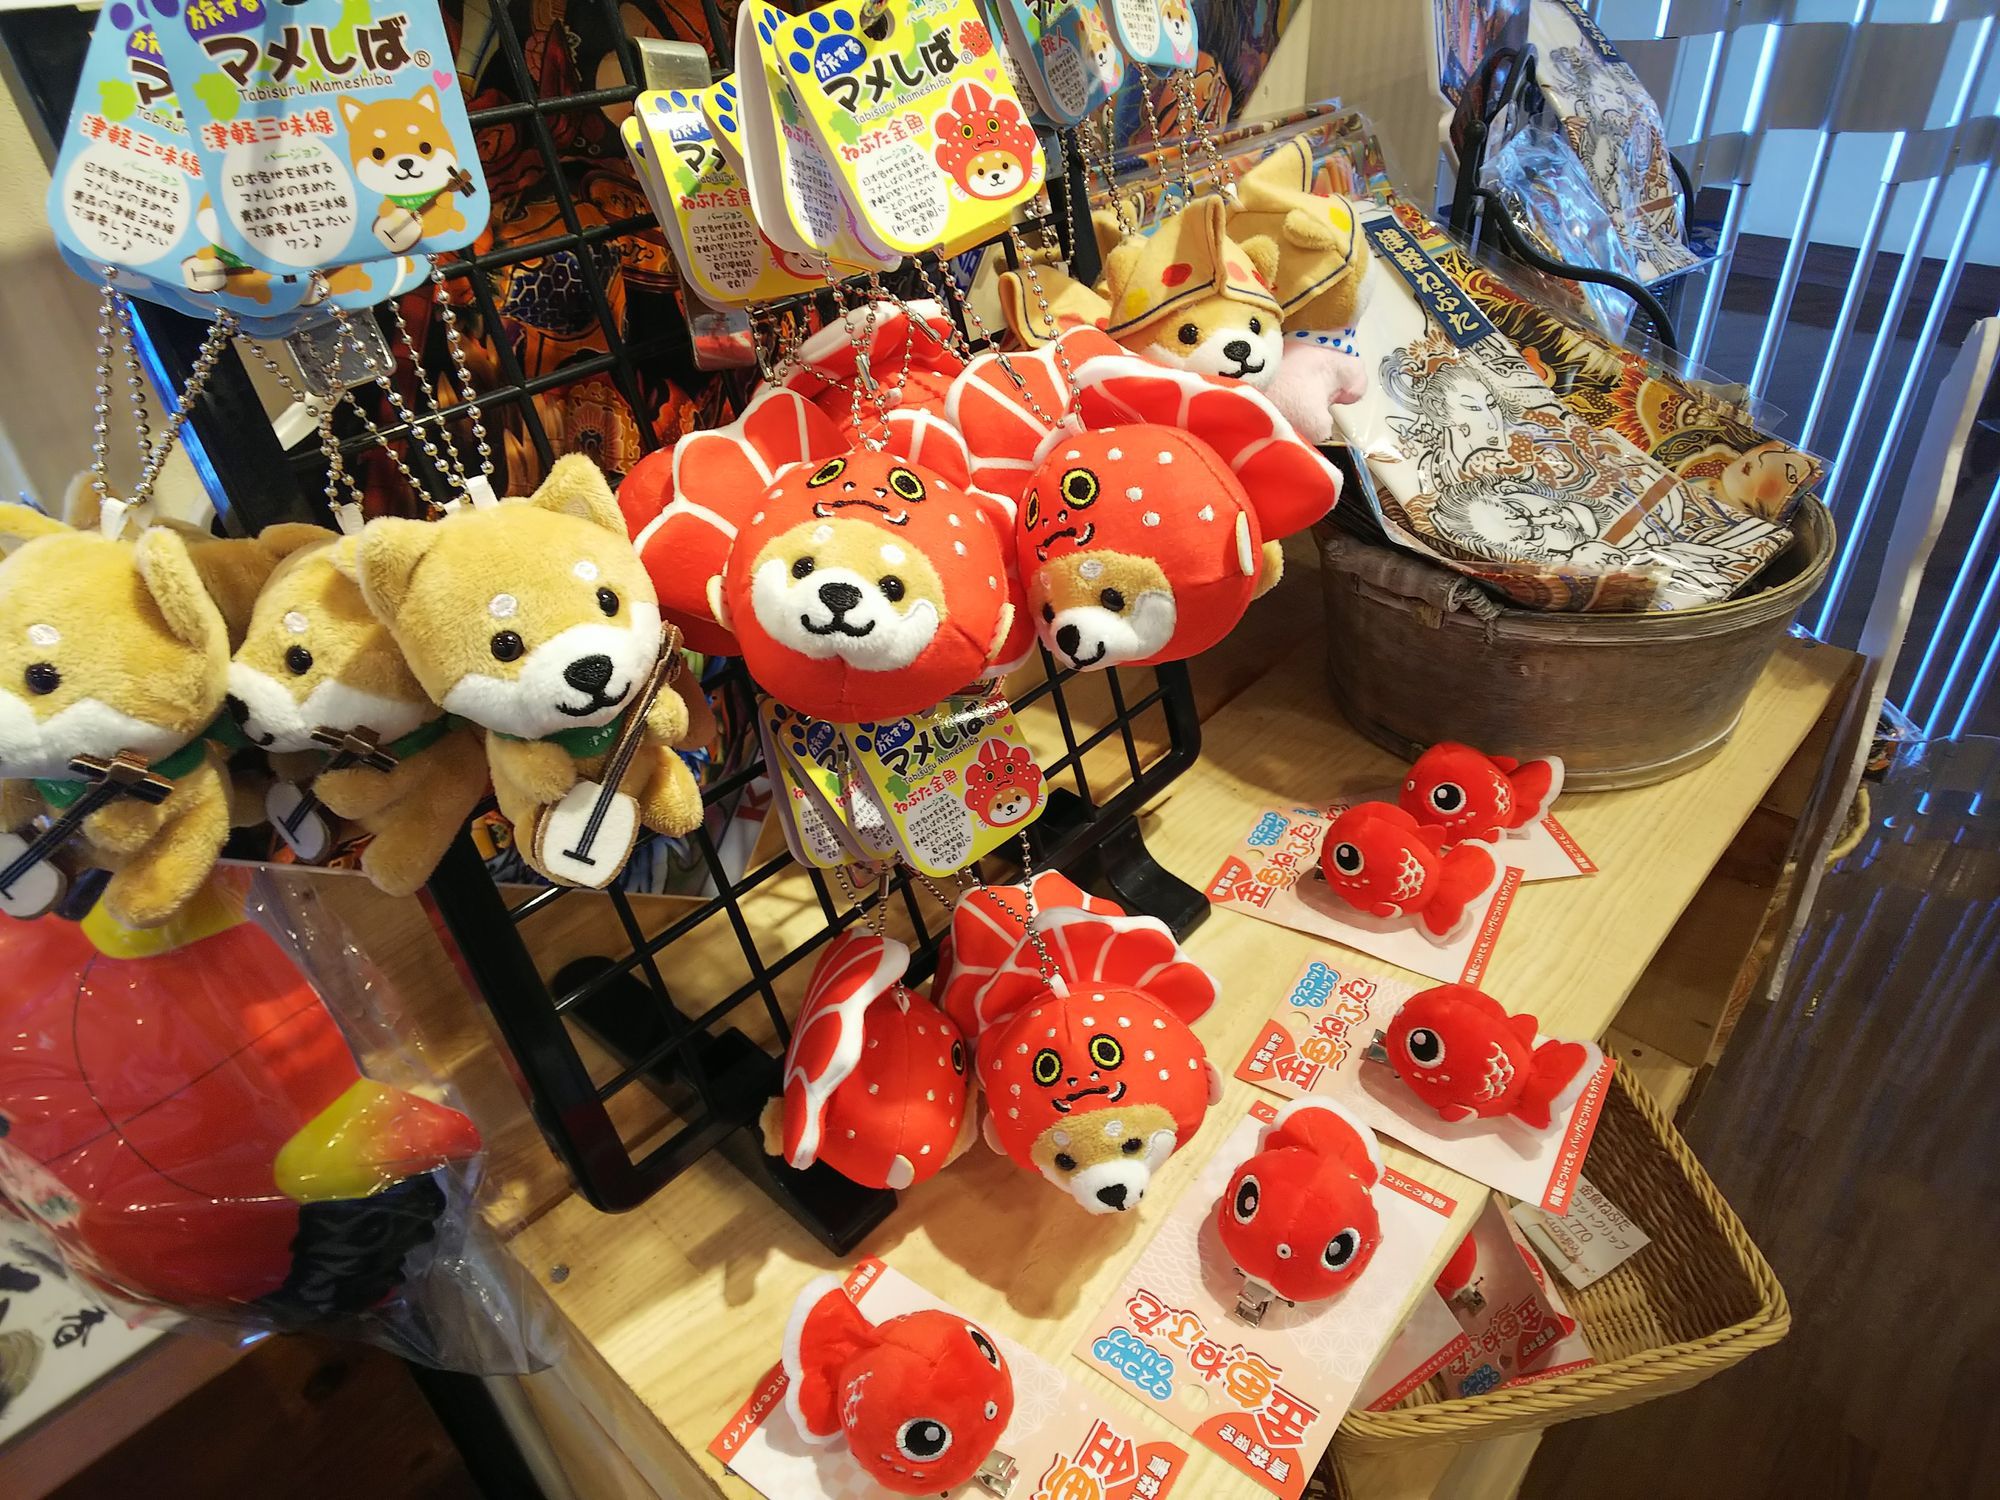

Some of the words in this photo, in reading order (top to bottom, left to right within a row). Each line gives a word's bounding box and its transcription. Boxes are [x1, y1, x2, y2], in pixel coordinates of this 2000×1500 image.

[204, 16, 411, 87] マメしば
[815, 39, 862, 79] 旅する
[823, 28, 960, 113] マメしば
[239, 83, 306, 103] Tabisuru
[310, 74, 394, 94] Mameshiba
[852, 102, 897, 125] Tabisuru
[897, 77, 952, 107] Mameshiba
[137, 104, 189, 136] Tabisur
[203, 109, 335, 150] 津軽三味線
[841, 114, 926, 161] ねぶた金魚
[83, 114, 202, 177] 津軽三味線
[232, 162, 333, 187] 日本各地を旅する
[240, 181, 337, 203] マメしばのまめた
[240, 196, 348, 223] 青森の津軽三味線
[246, 215, 352, 239] で演奏してみたい
[877, 721, 911, 753] 旅する
[902, 763, 938, 787] Tabisuru
[937, 735, 980, 766] Mameshiba
[893, 769, 958, 814] ねぶた金魚
[1249, 811, 1281, 846] マスコット
[1263, 816, 1291, 845] クリップ
[1236, 822, 1319, 910] 金魚ねぶた
[1292, 962, 1328, 1007] マスコット
[1308, 967, 1339, 1008] クリップ
[1248, 1032, 1283, 1073] 青森限定
[1274, 978, 1378, 1090] 金魚ねぶた
[1387, 1173, 1446, 1210] 前髪につけて
[1570, 1196, 1630, 1250] コットクリップ
[1096, 1343, 1171, 1399] マスコット
[1110, 1330, 1173, 1377] クリップ
[1127, 1289, 1320, 1447] 金魚ねぶた
[730, 1373, 788, 1441] けてもカワイイ
[1217, 1423, 1291, 1485] 青森限定
